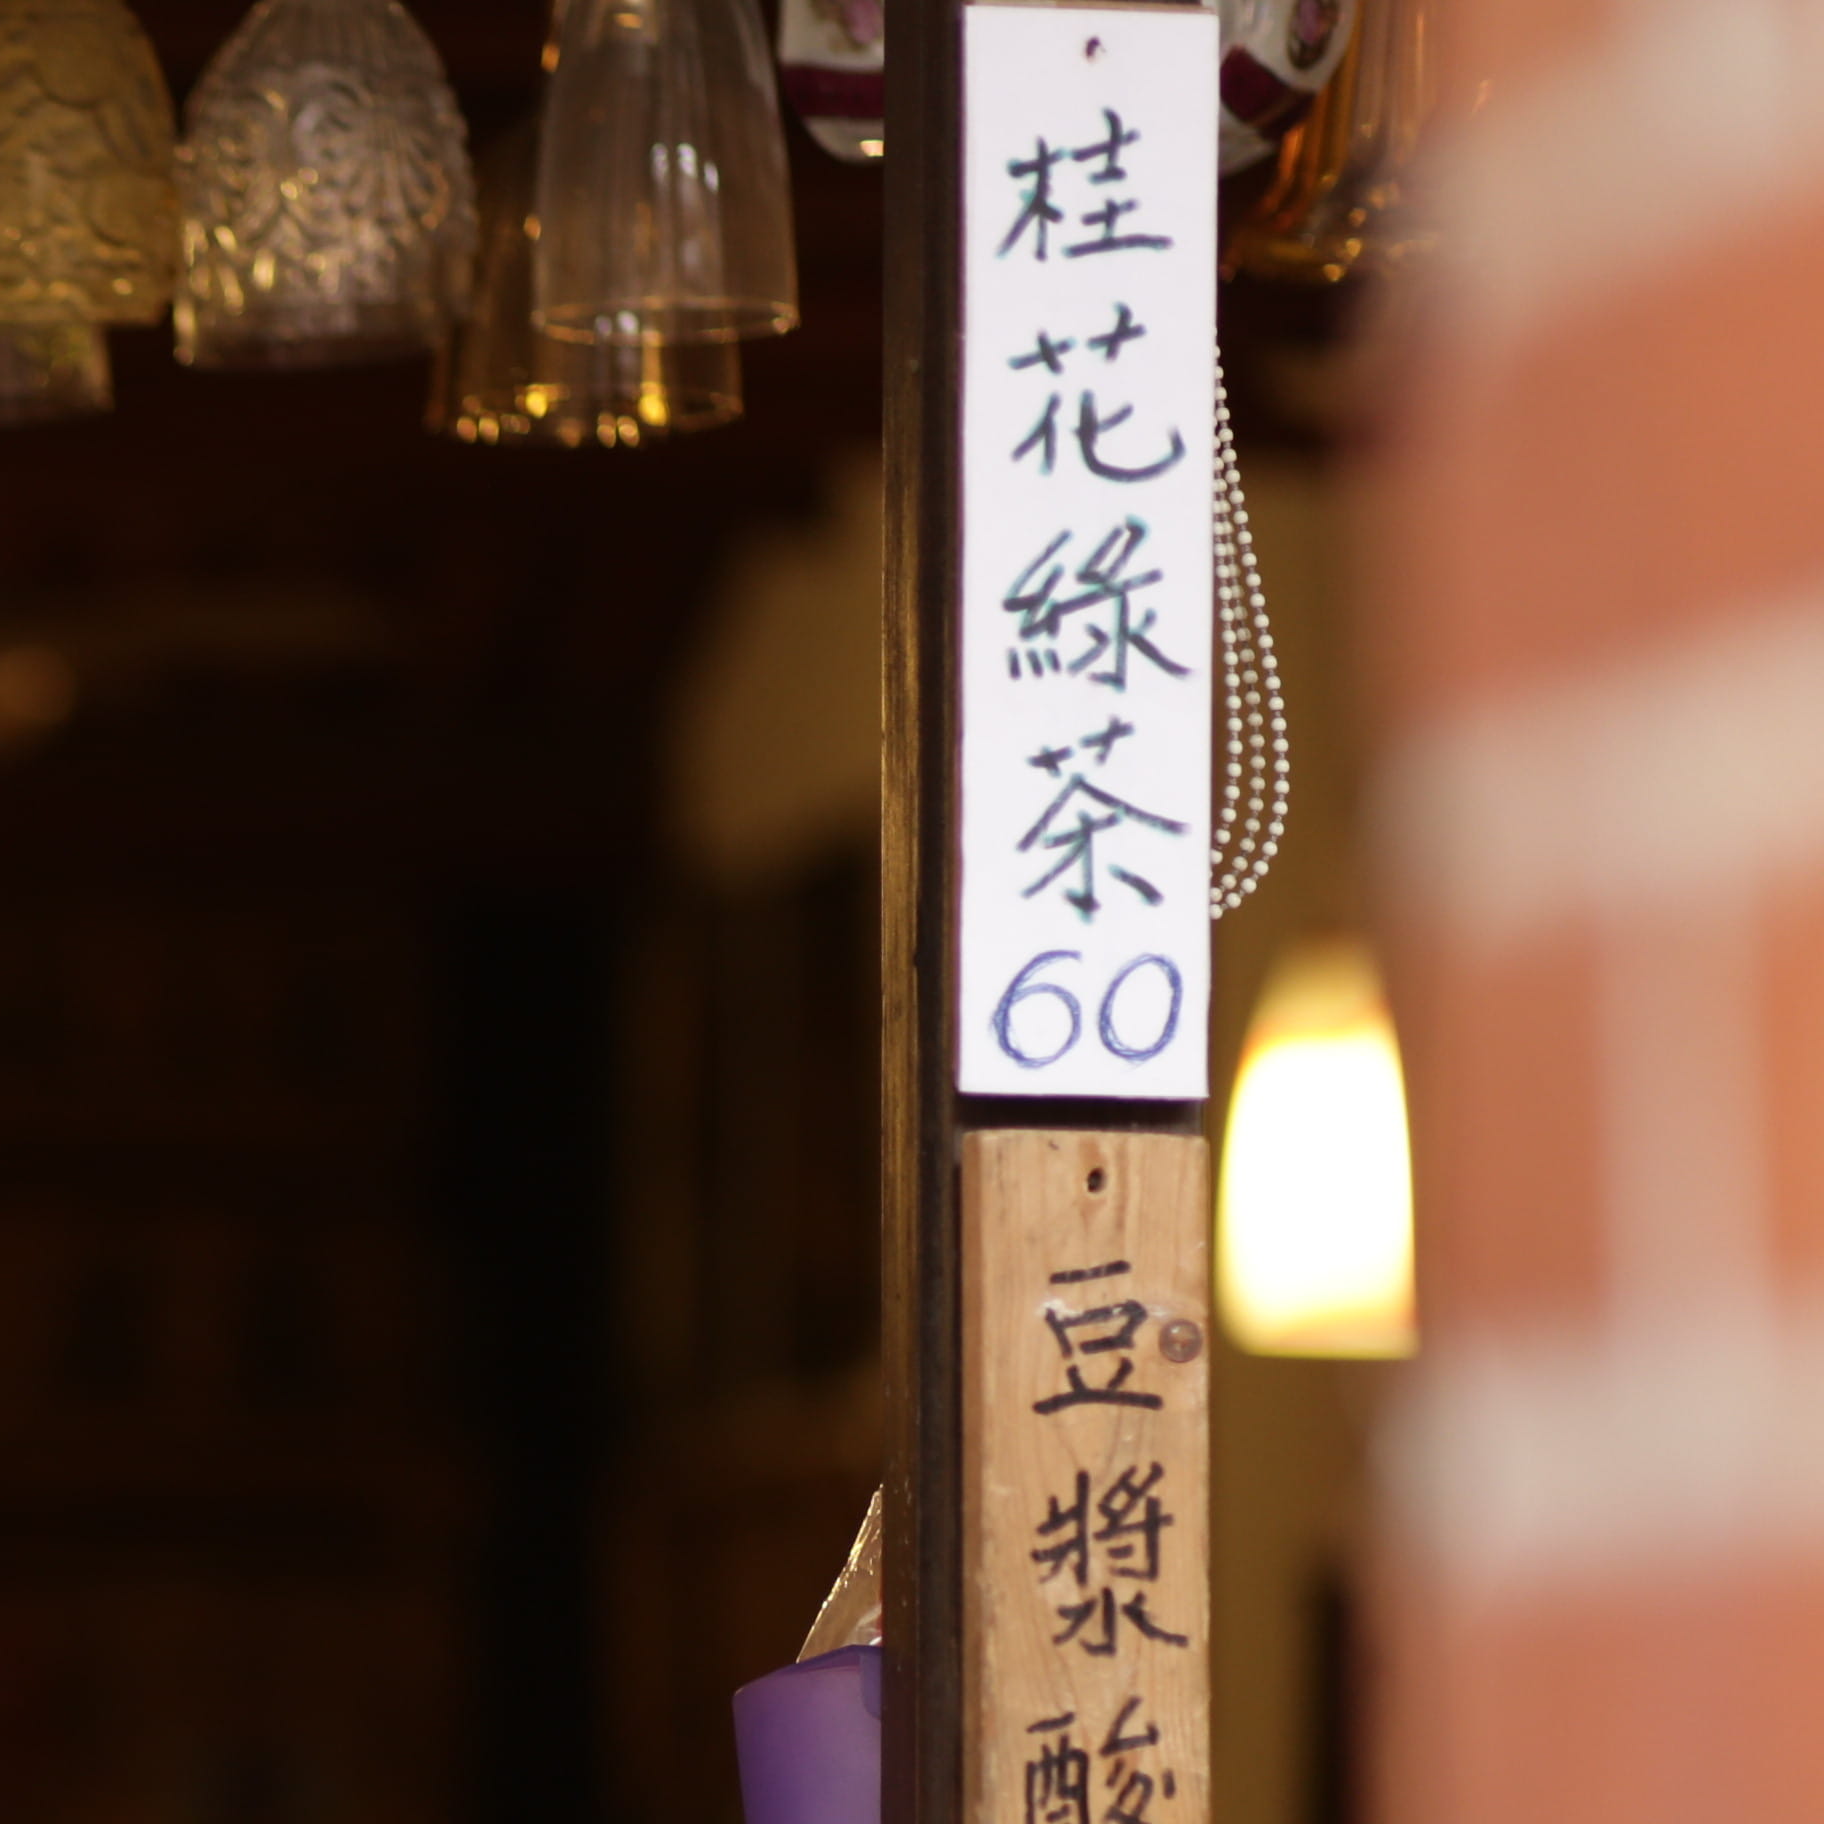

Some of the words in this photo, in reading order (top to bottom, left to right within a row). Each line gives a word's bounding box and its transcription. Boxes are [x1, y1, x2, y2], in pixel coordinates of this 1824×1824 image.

[995, 107, 1192, 924] 桂花綠茶
[991, 948, 1184, 1070] 60
